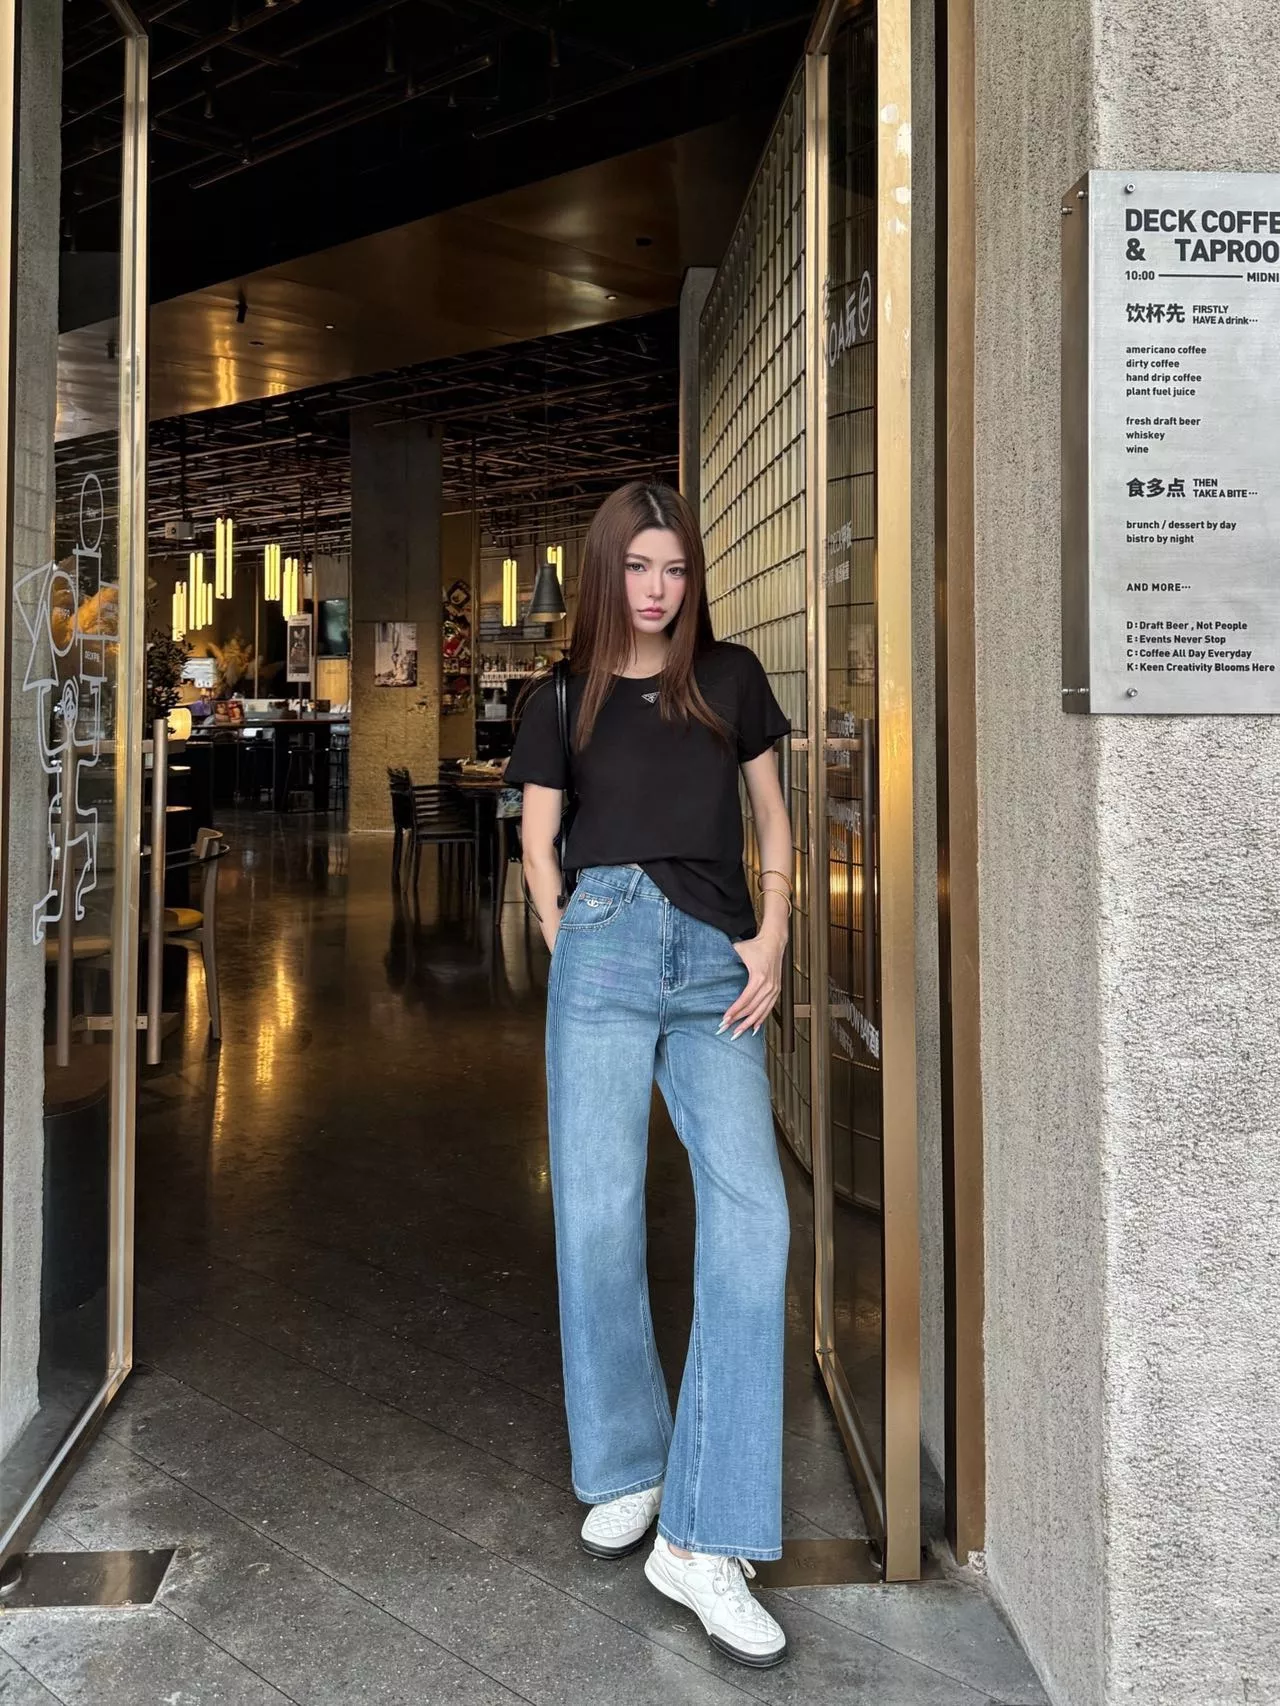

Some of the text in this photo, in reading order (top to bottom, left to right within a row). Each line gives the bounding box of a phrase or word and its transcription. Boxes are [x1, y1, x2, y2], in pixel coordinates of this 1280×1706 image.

[1125, 209, 1197, 233] DECK
[1126, 238, 1280, 263] & TAPROO
[1125, 270, 1155, 280] 10:00
[1126, 303, 1185, 323] 饮杯先
[1193, 305, 1229, 313] FIRSTLY
[1193, 316, 1216, 324] HAVE
[1217, 316, 1225, 324] A
[1126, 345, 1206, 354] americano coffee
[1126, 359, 1179, 369] dirty coffee
[1126, 373, 1202, 383] hand drip coffee
[1126, 387, 1196, 398] plant fuel juice
[1126, 417, 1201, 425] fresh draft beer
[1126, 431, 1165, 441] whiskey
[1126, 445, 1149, 453] wine
[1127, 477, 1186, 498] 食多点
[1193, 479, 1218, 487] THEN
[1193, 490, 1218, 498] TAKE
[1127, 520, 1160, 529] brunch
[1168, 521, 1204, 529] dessert
[1207, 520, 1218, 531] by
[1220, 520, 1236, 531] day
[1127, 534, 1194, 544] bistro by night
[1127, 583, 1148, 592] AND
[1166, 622, 1189, 630] Beer
[1196, 622, 1212, 630] Not
[1215, 622, 1248, 631] People
[1174, 635, 1202, 644] Never
[1204, 635, 1226, 645] Stop
[1172, 649, 1186, 658] All
[1188, 649, 1206, 659] Day
[1208, 649, 1252, 659] Everyday
[1166, 663, 1212, 673] Creativity
[1215, 663, 1250, 672] Blooms
[1252, 663, 1275, 672] Here
